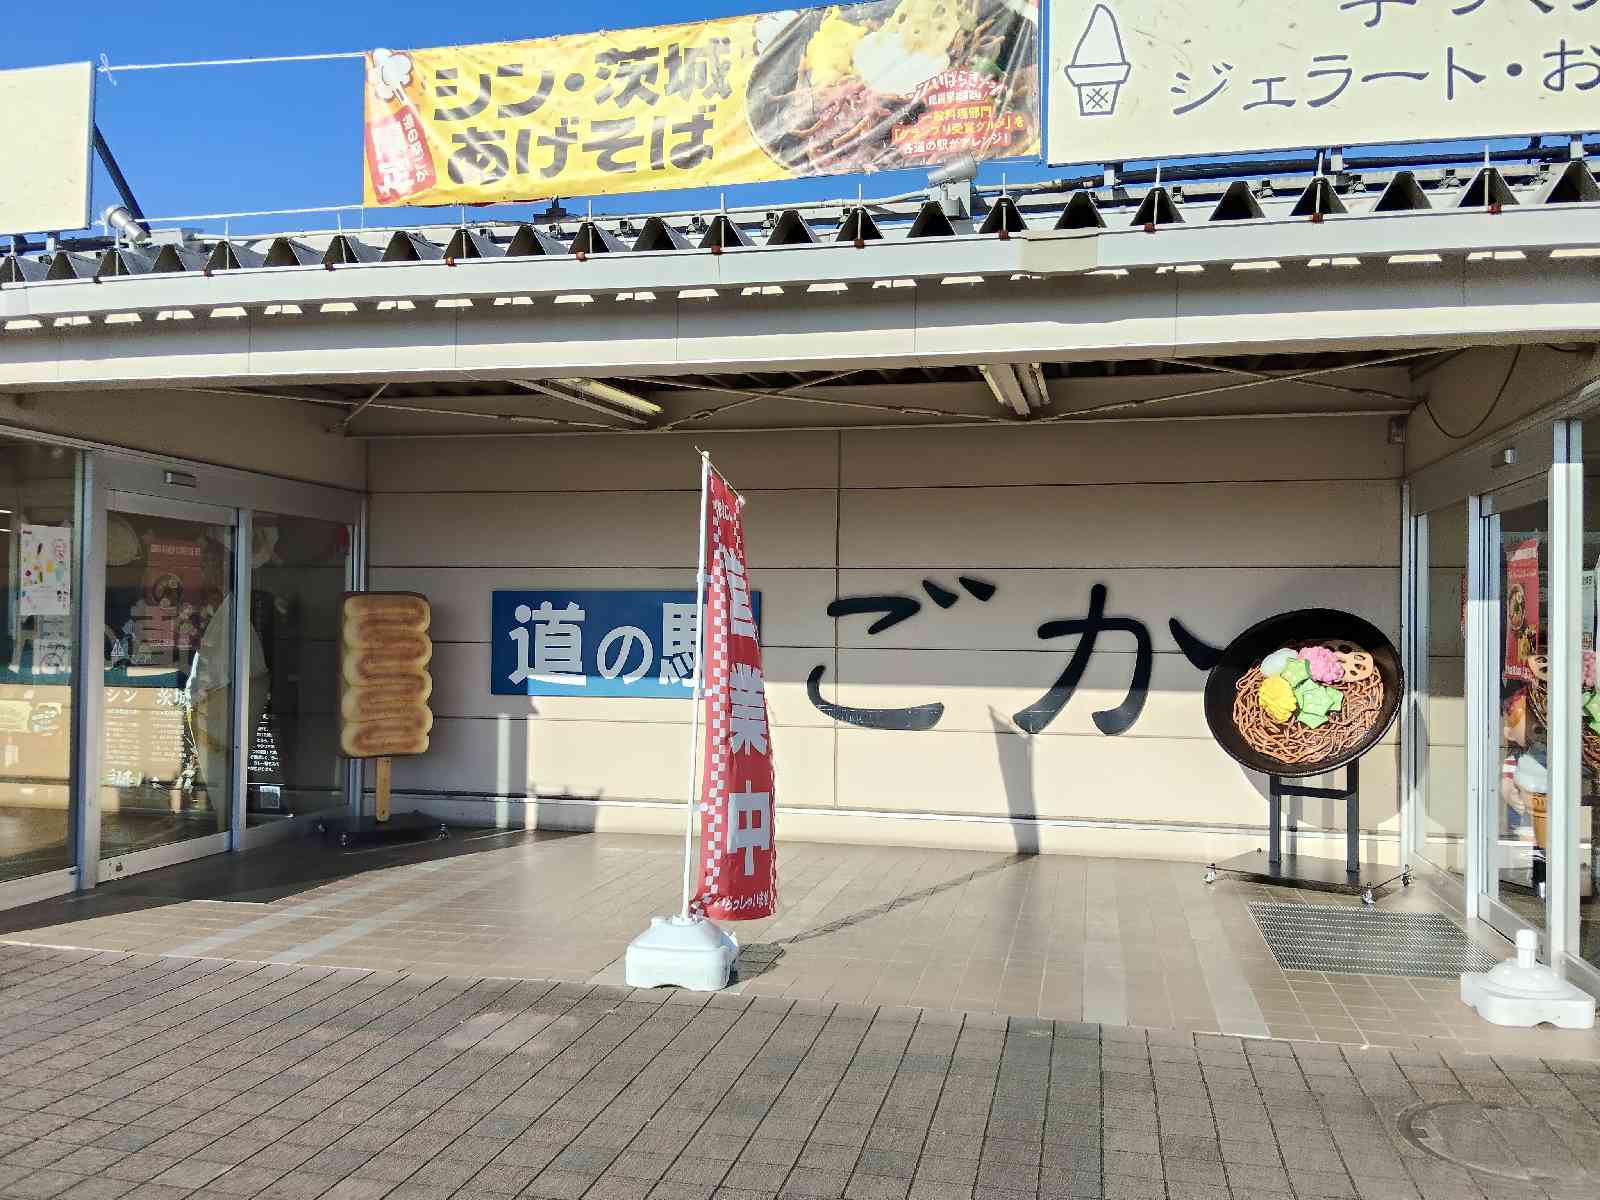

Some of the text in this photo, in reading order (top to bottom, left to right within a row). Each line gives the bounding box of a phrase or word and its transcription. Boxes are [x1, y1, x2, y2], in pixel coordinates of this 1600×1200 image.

[433, 36, 733, 121] シン・茨城
[1170, 38, 1600, 116] ジェラート・お
[447, 104, 717, 186] あげそば
[806, 575, 1226, 736] ごか
